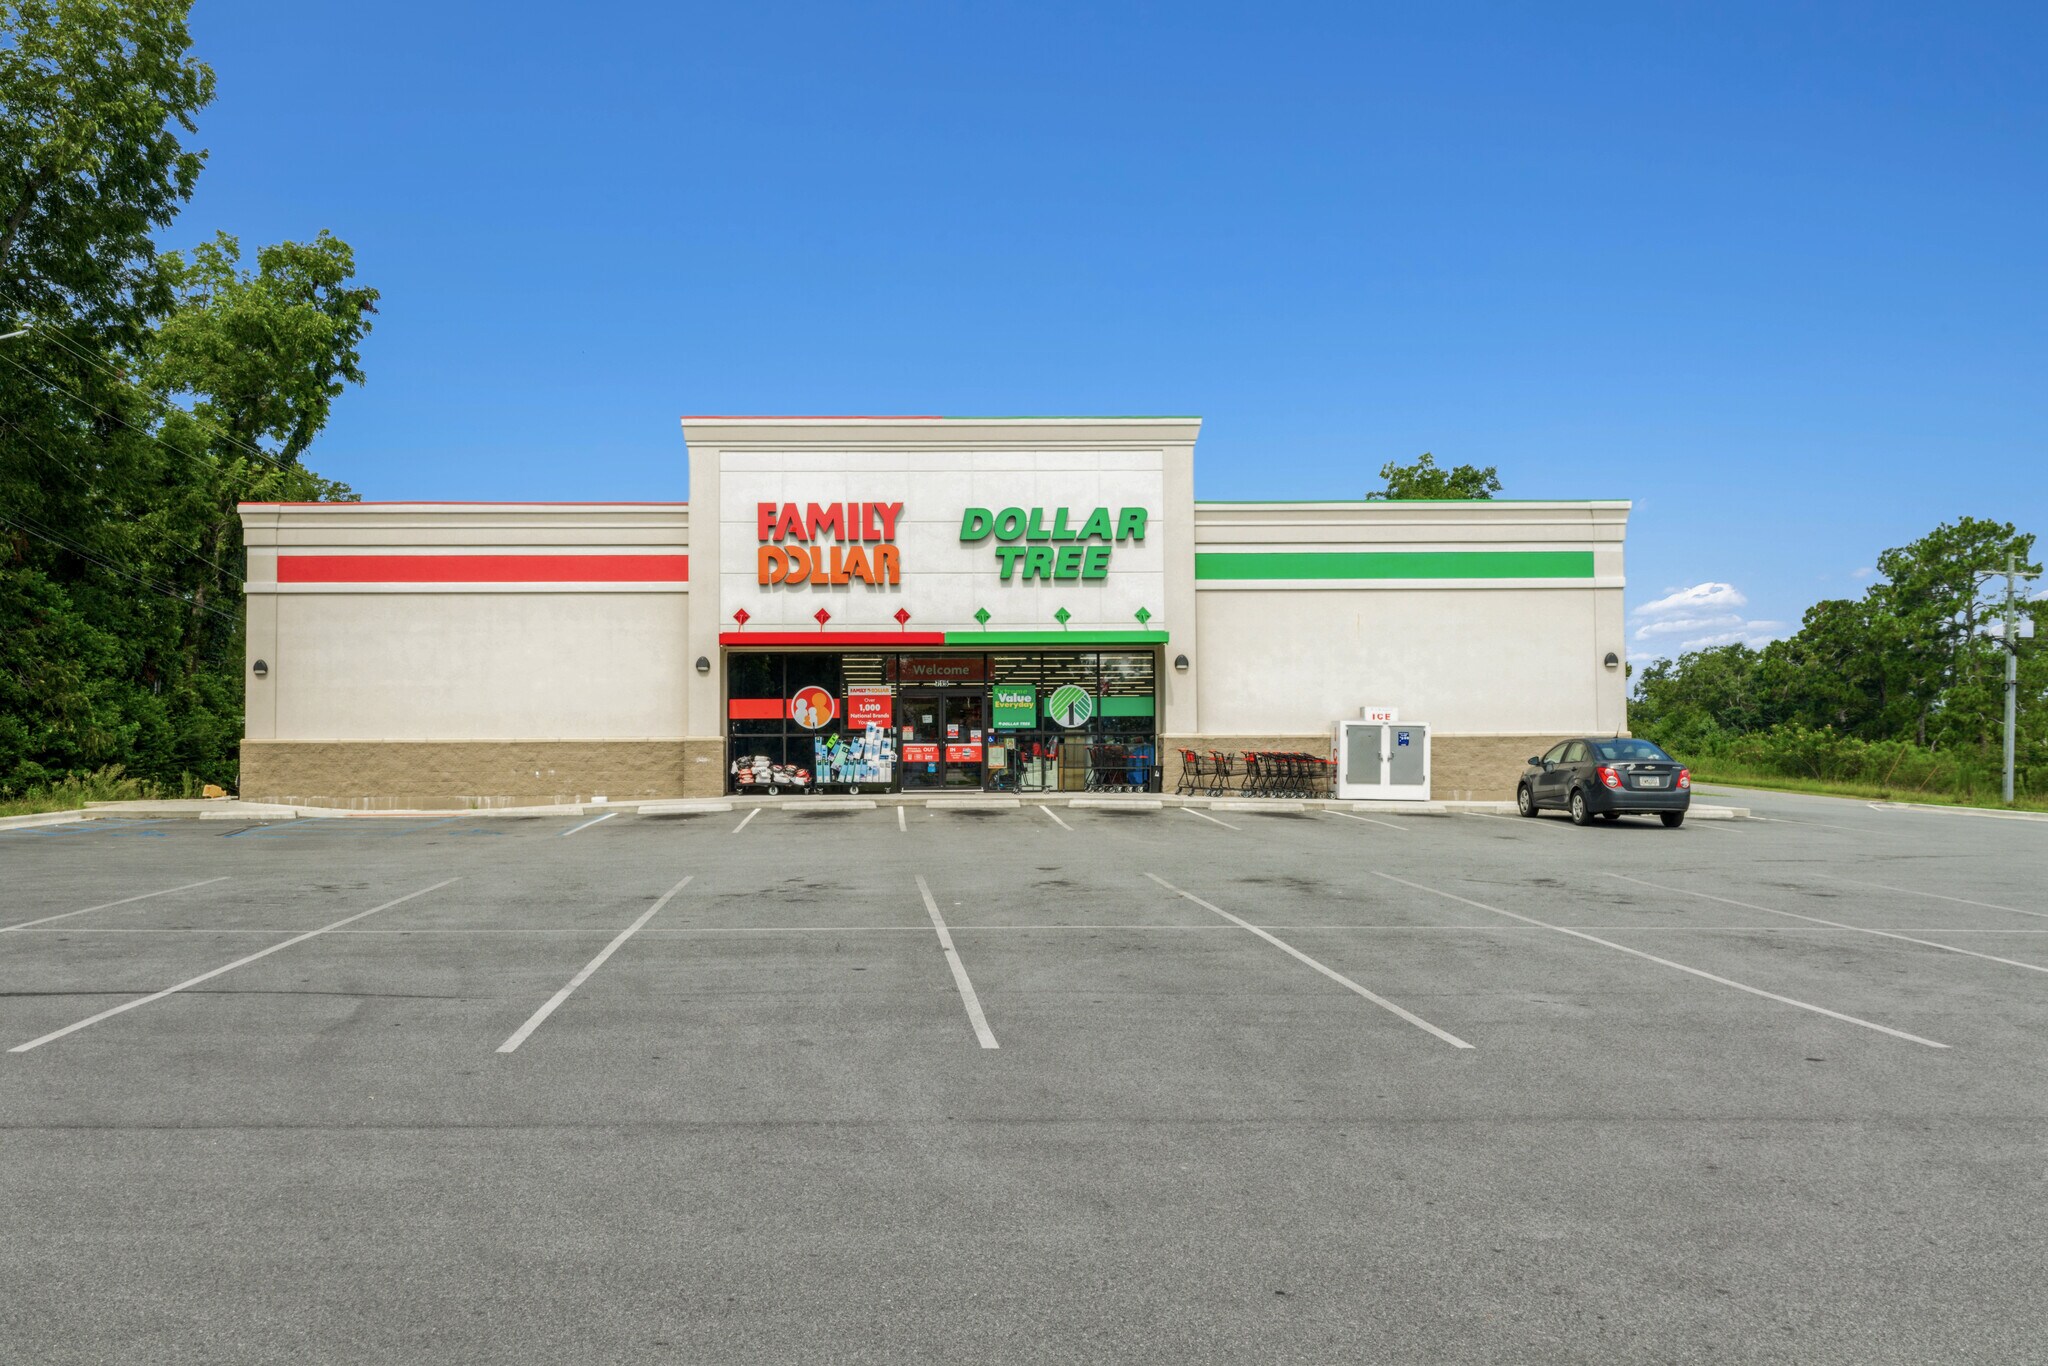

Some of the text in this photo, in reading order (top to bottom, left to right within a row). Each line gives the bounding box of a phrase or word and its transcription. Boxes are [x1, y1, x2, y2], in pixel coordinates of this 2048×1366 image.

[757, 502, 904, 542] FAMILY
[959, 507, 1149, 542] DOLLAR
[757, 544, 900, 586] DOLLAR
[995, 546, 1113, 580] TREE
[913, 664, 970, 675] Welcome
[859, 704, 881, 712] 1,000
[995, 701, 1034, 709] Everyday
[998, 693, 1032, 703] Value
